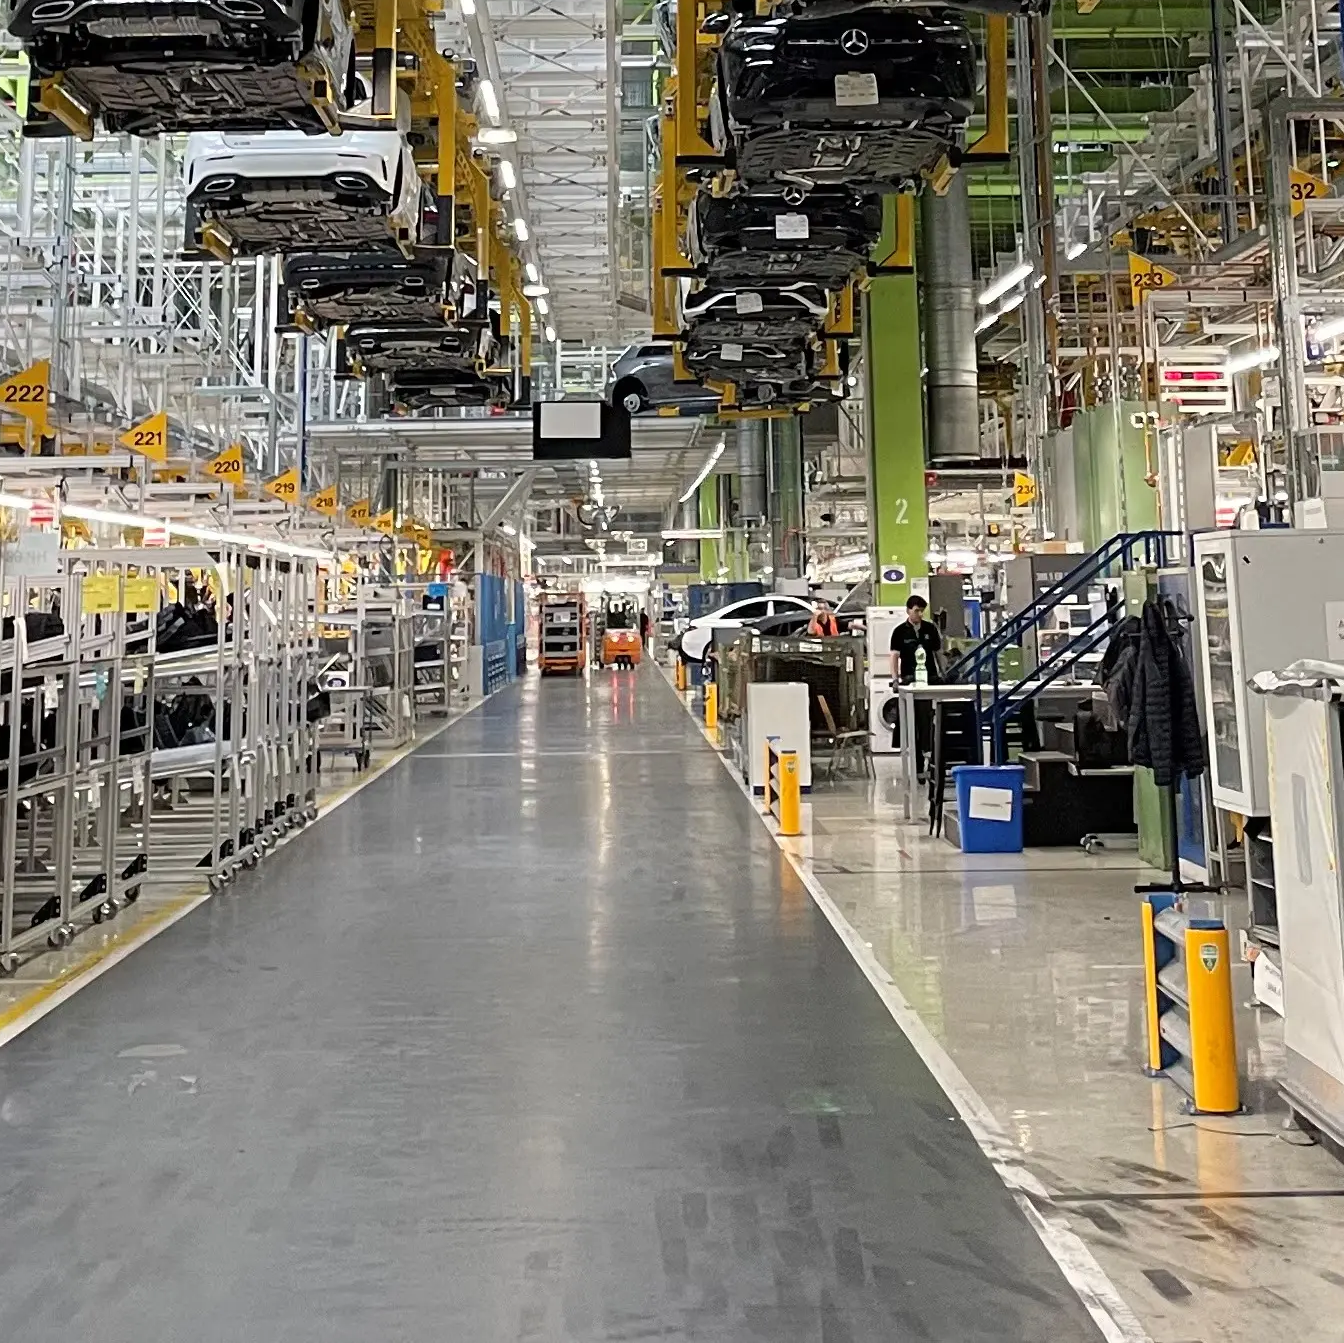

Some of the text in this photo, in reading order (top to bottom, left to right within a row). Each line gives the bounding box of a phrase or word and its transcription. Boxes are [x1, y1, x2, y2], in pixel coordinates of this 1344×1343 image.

[1290, 182, 1317, 201] 32
[1133, 272, 1163, 287] 233
[5, 385, 45, 403] 222
[134, 431, 163, 446] 221
[214, 459, 240, 474] 220
[274, 482, 295, 493] 219
[316, 498, 334, 507] 218
[895, 498, 909, 525] 2
